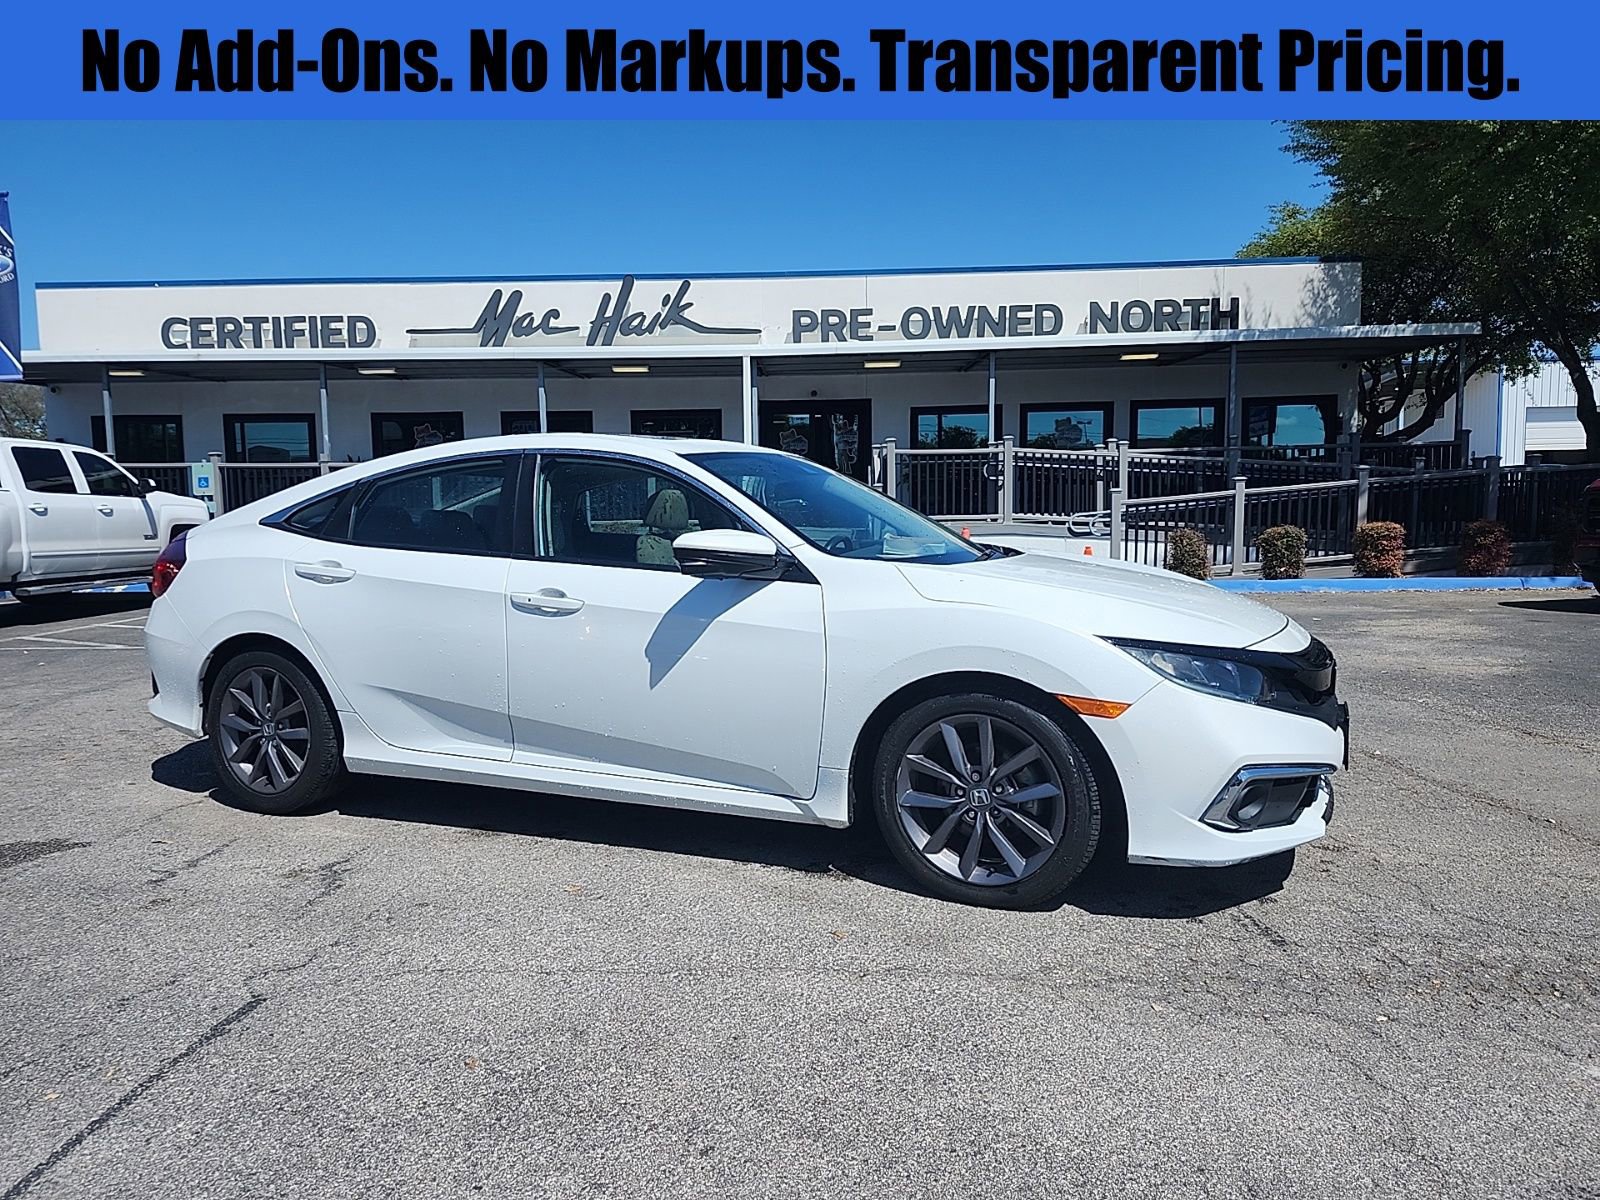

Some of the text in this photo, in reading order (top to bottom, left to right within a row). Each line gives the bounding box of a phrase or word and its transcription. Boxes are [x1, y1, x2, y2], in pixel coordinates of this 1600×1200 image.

[160, 315, 377, 349] CERTIFIED
[406, 275, 762, 348] Mac Haik
[792, 297, 1240, 343] PRE-OWNED NORTH
